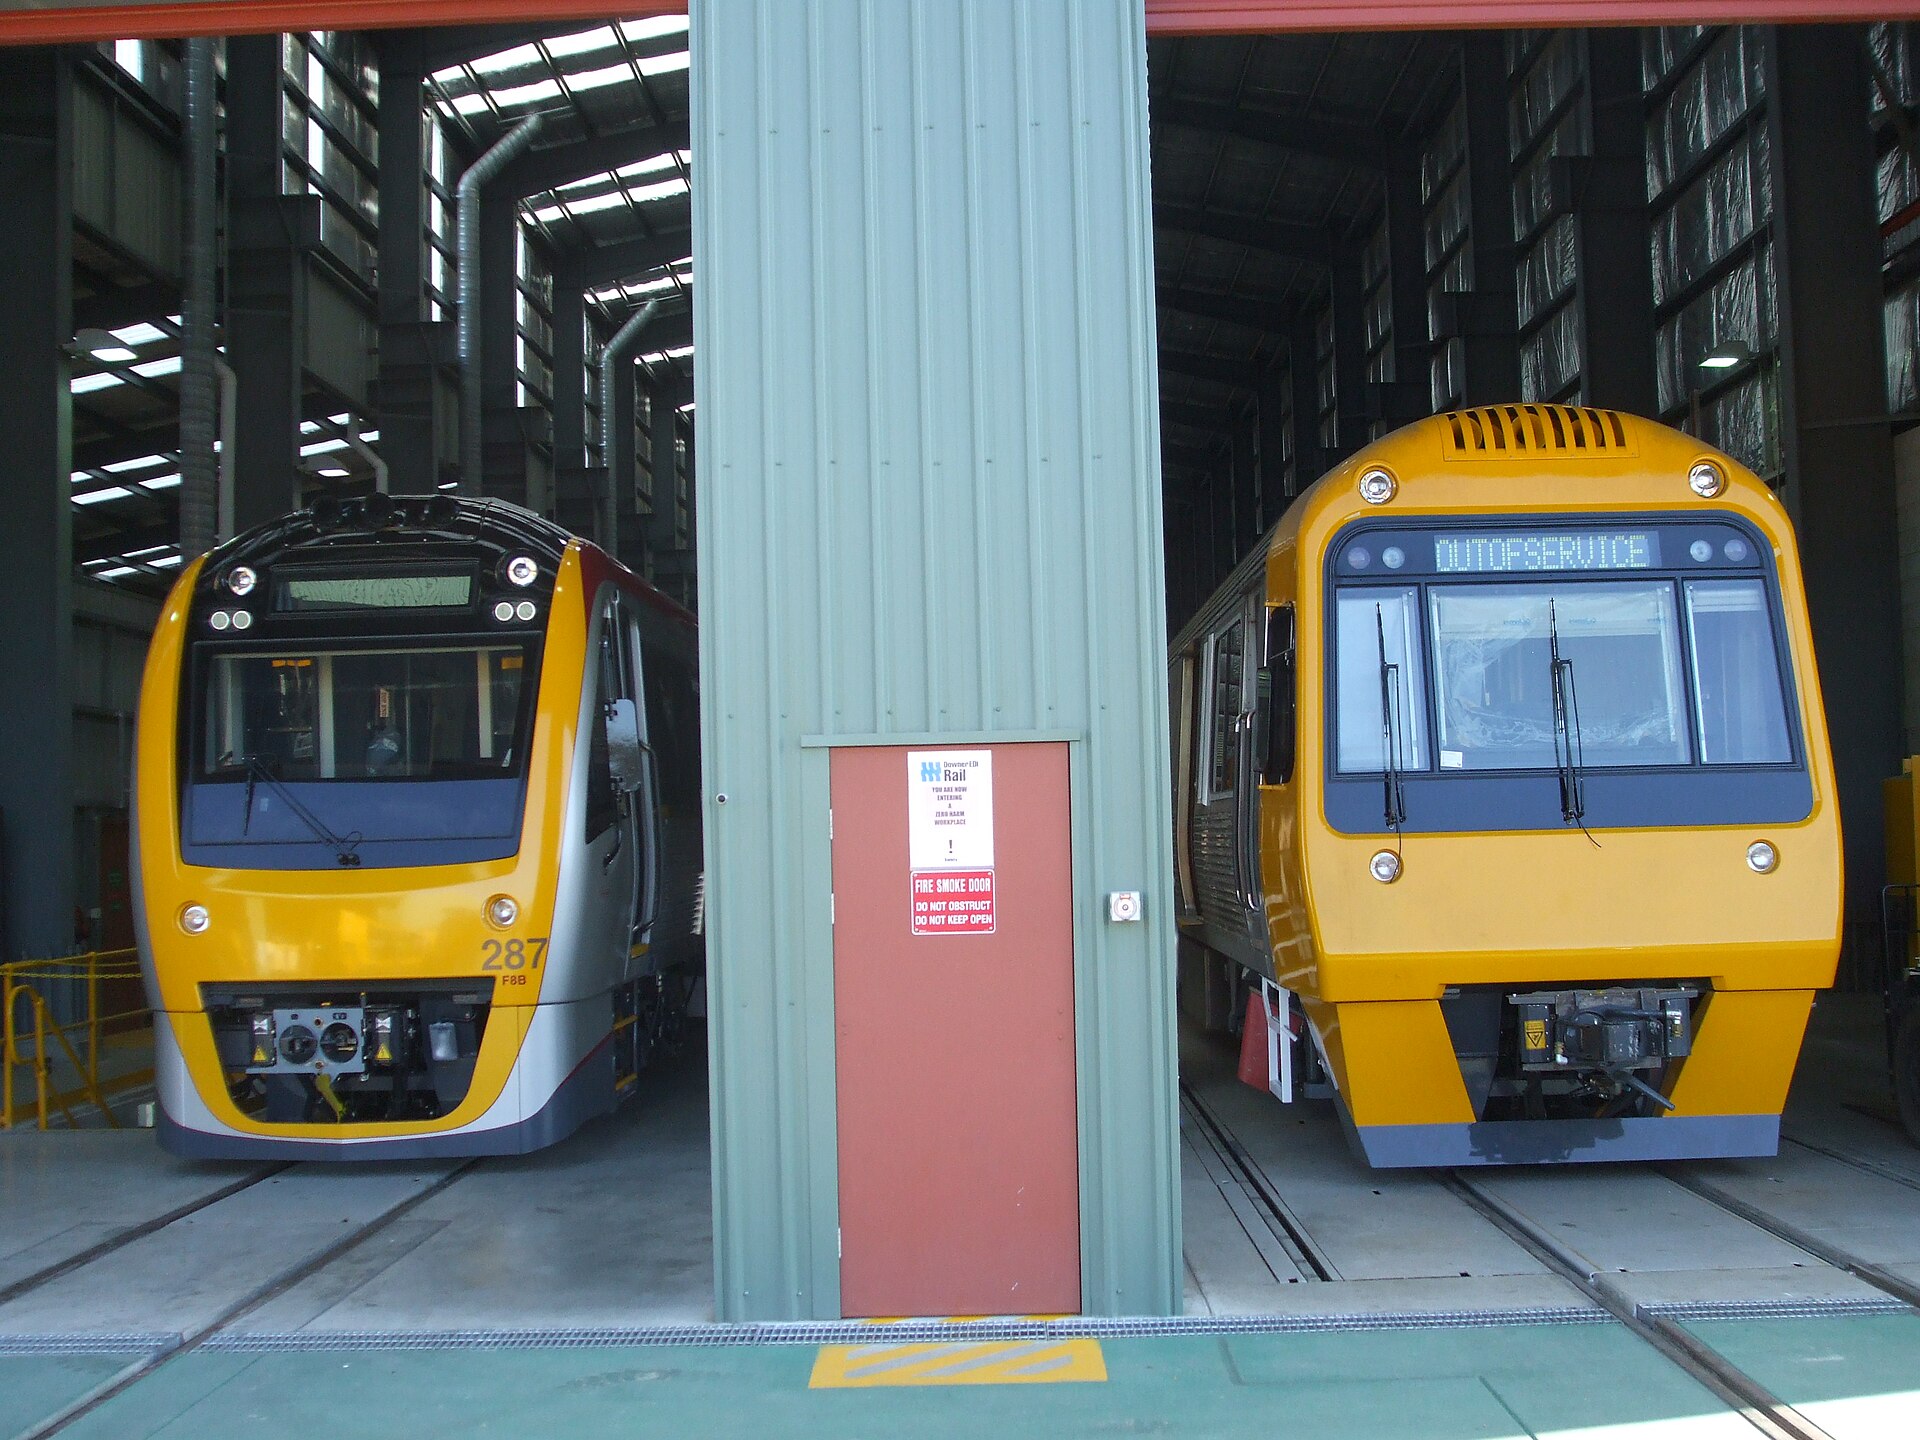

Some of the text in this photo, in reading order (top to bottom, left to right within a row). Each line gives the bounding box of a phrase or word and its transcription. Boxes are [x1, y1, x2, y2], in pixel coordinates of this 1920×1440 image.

[944, 769, 966, 781] Rail
[915, 877, 991, 893] FIRE SMOKE DOOR
[916, 900, 991, 912] DO NOT OBSTRUCT
[915, 914, 992, 925] DO NOT KEEP OPEN
[481, 937, 548, 971] 287
